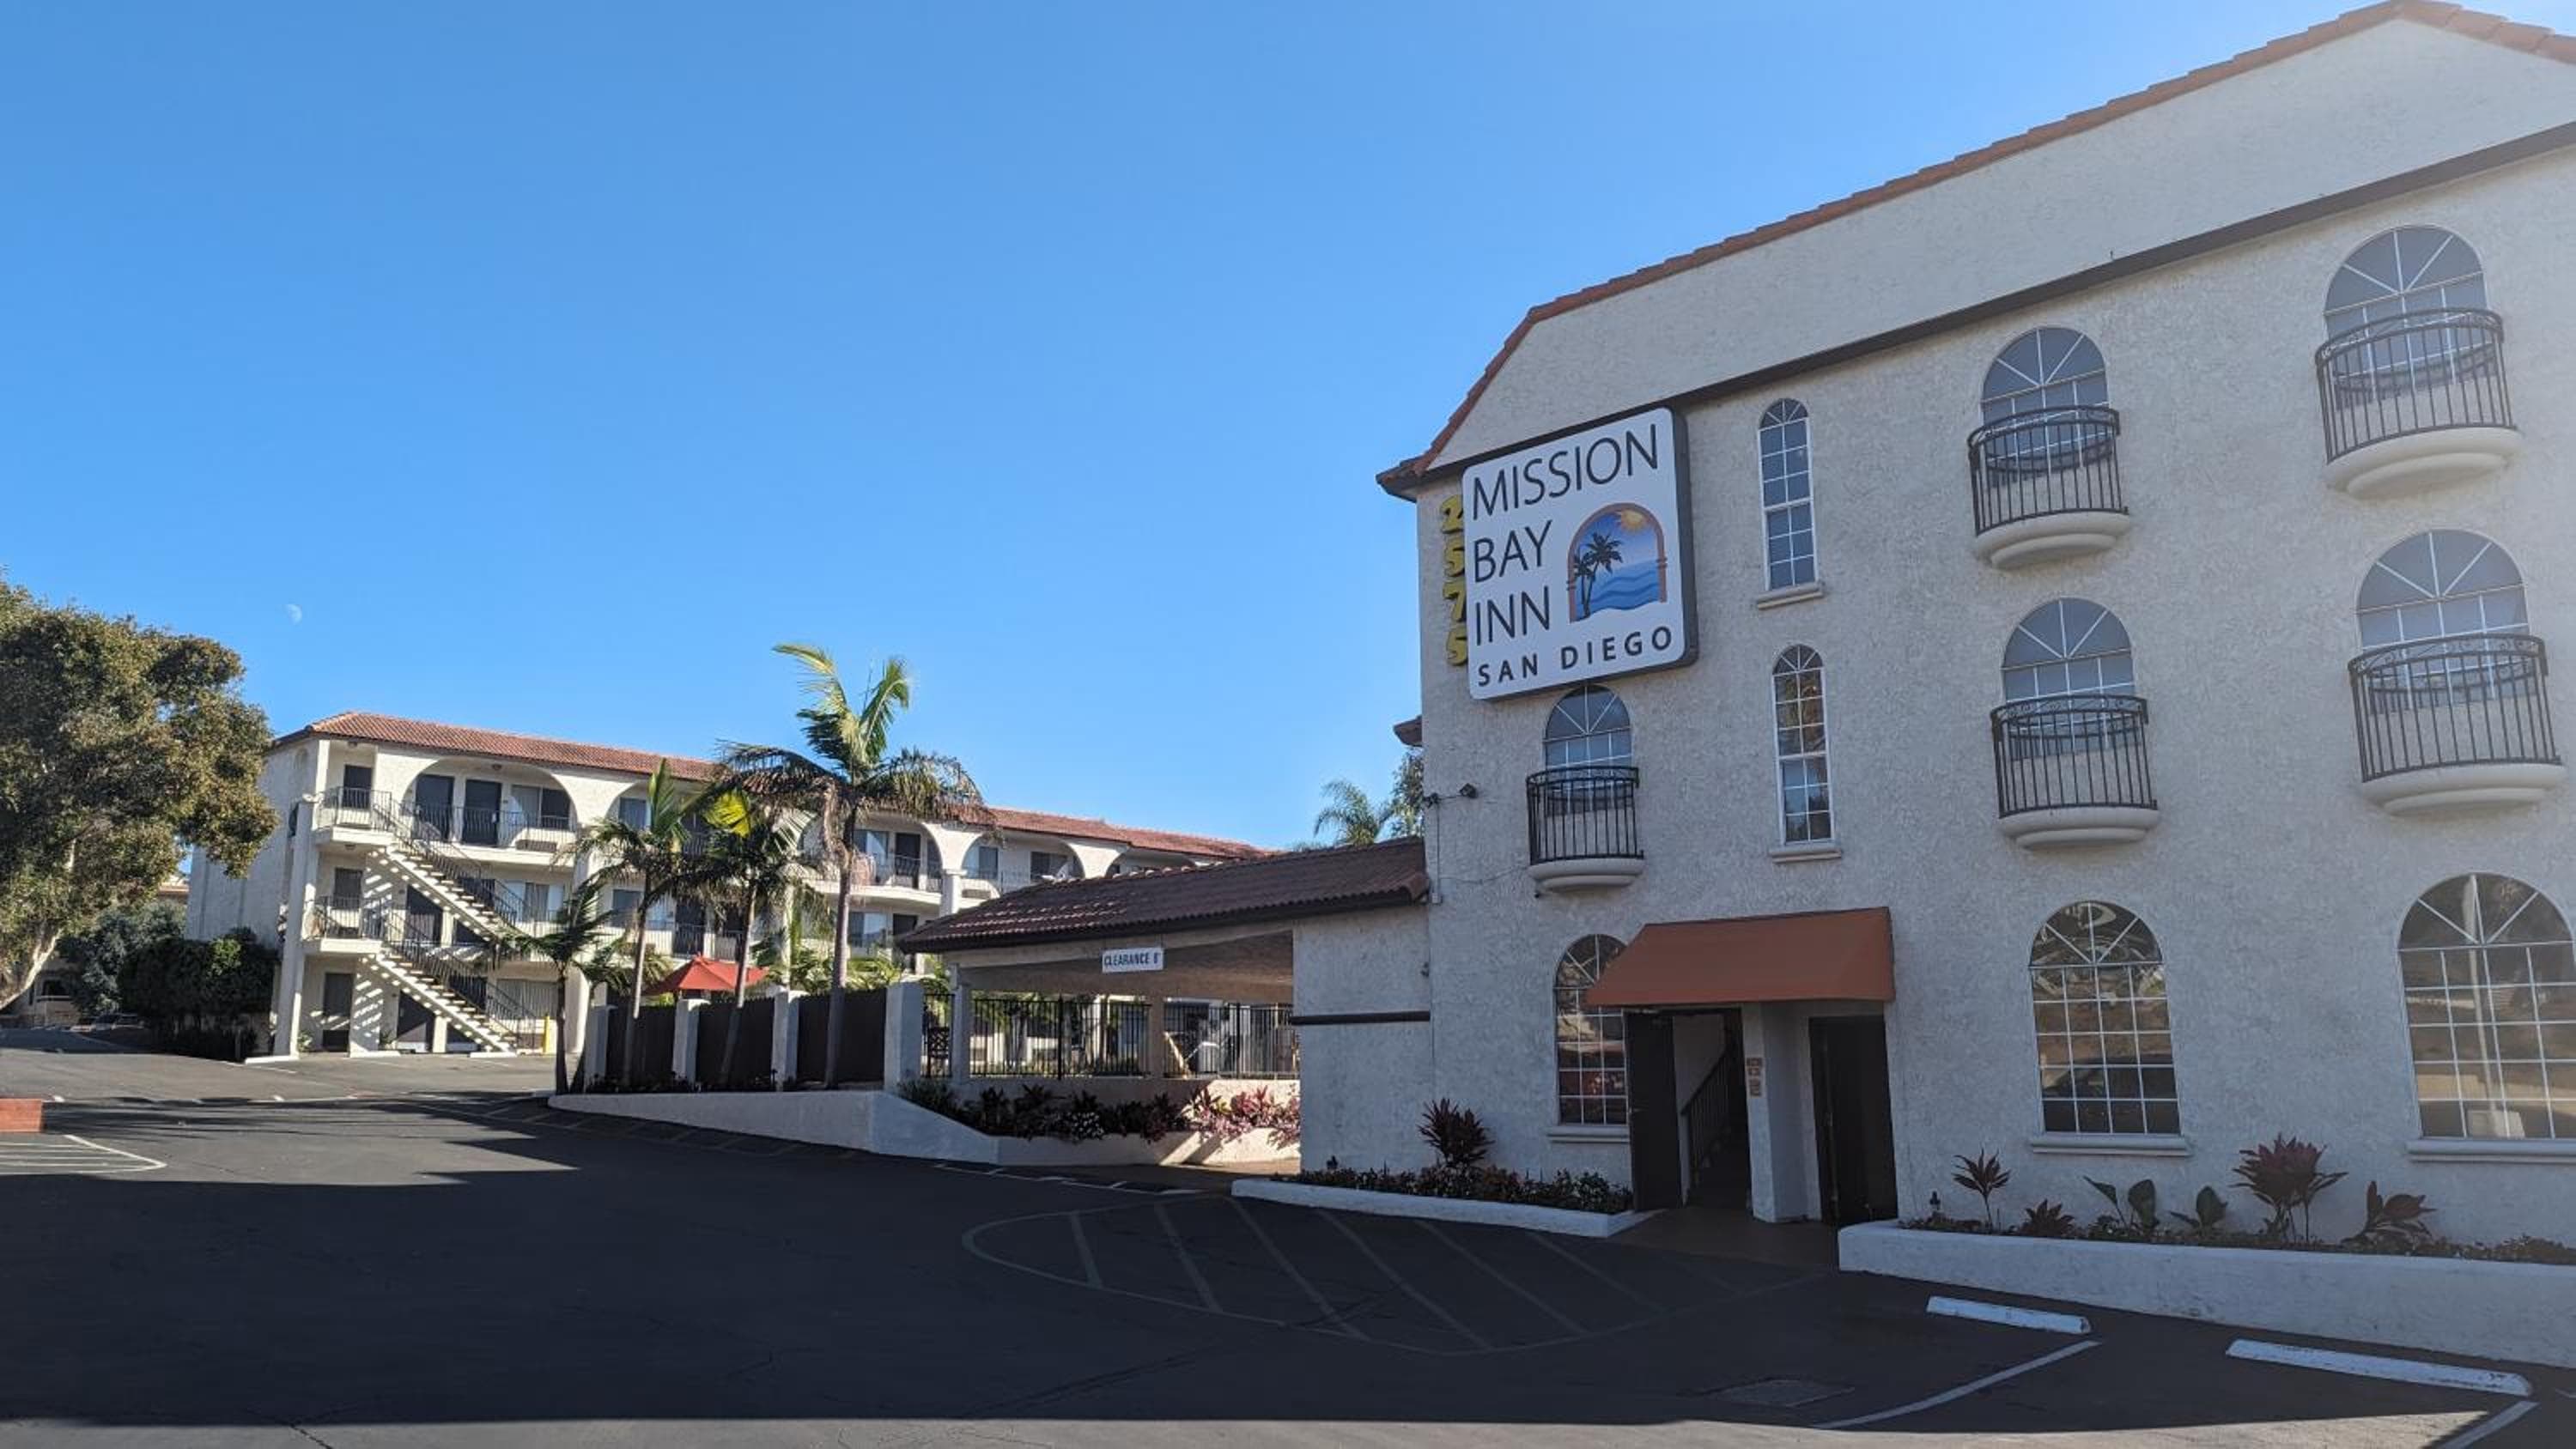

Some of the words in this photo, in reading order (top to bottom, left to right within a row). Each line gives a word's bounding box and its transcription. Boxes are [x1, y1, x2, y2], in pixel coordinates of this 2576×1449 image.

[1473, 424, 1657, 520] MISSION
[1473, 520, 1552, 582] BAY
[1475, 585, 1550, 646] INN
[1478, 653, 1538, 686] SAN
[1560, 626, 1671, 670] DIEGO
[1104, 952, 1149, 966] CLEARANCE
